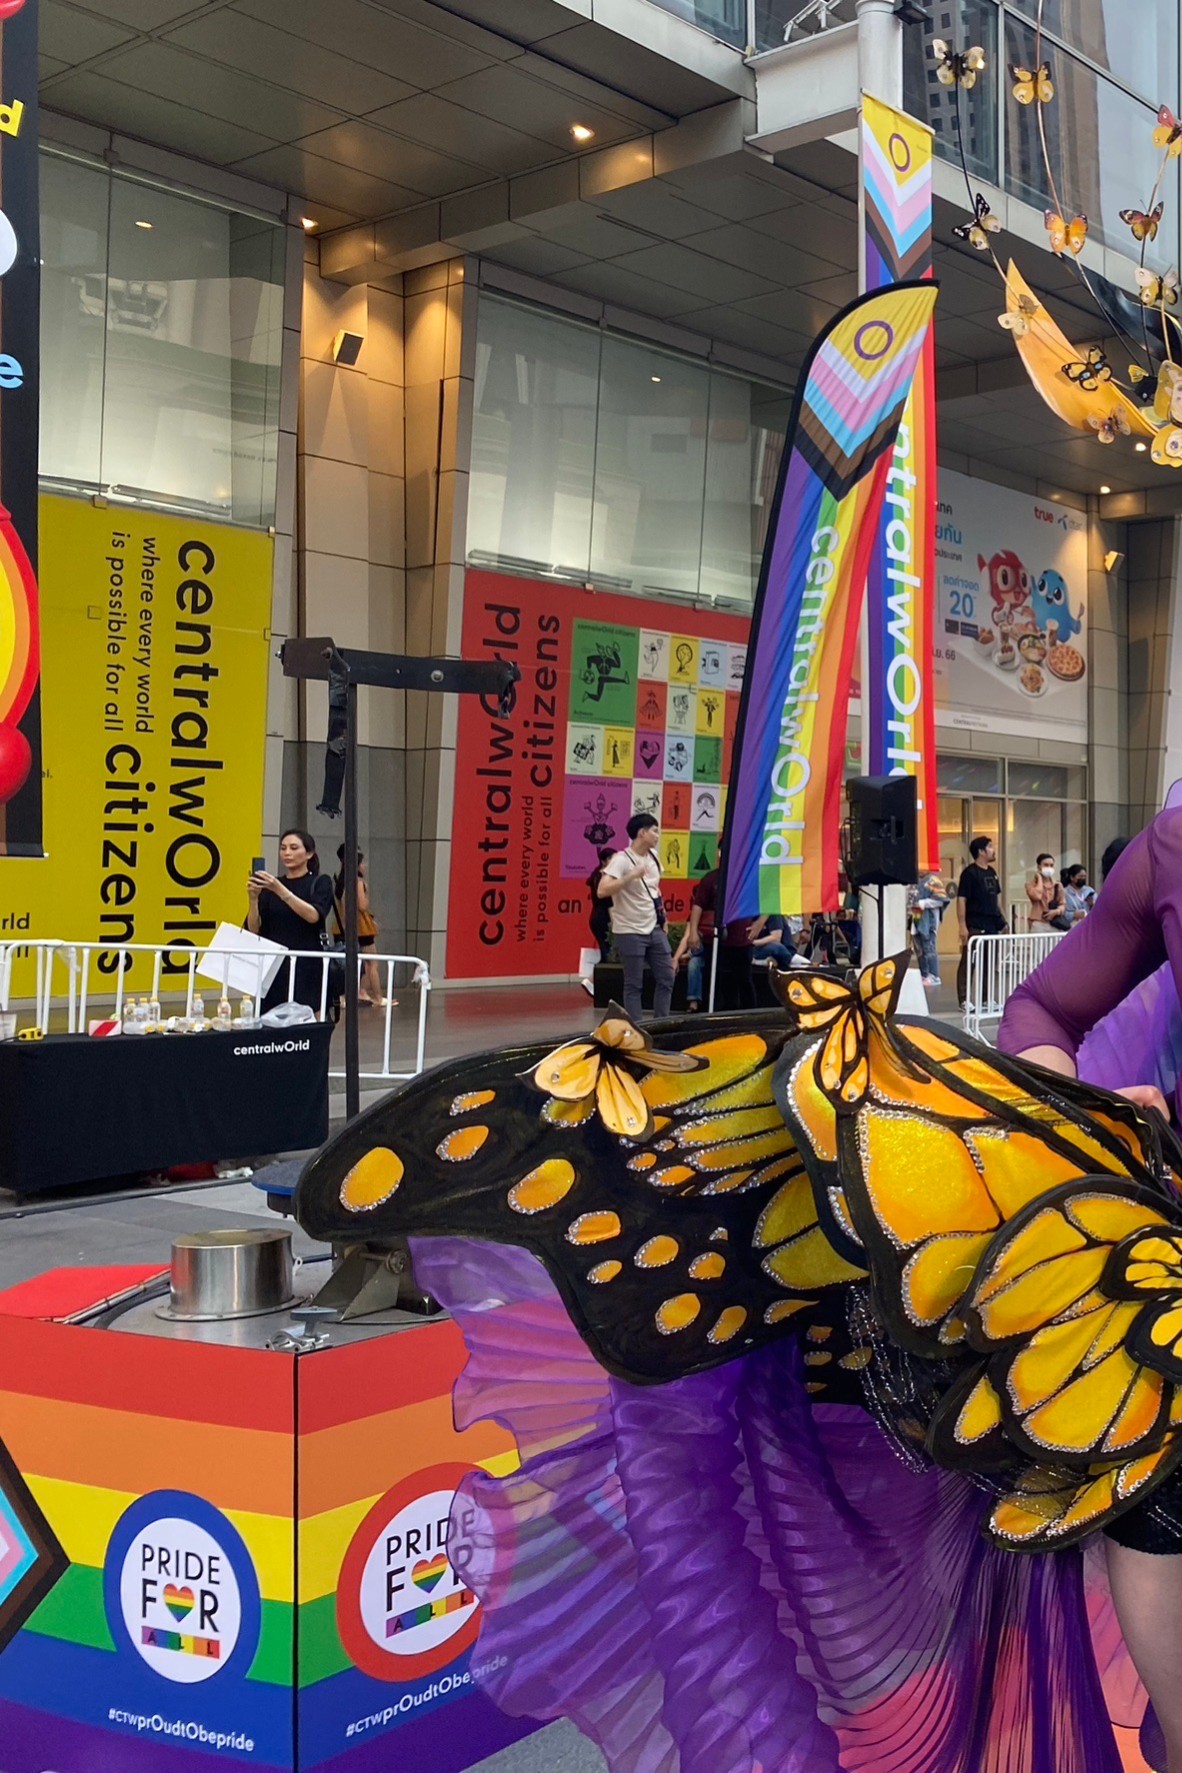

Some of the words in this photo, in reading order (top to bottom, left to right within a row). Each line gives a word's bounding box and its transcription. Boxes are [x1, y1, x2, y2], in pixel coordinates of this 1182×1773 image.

[1034, 506, 1054, 524] true
[111, 531, 131, 549] is
[140, 537, 161, 602] where
[105, 556, 128, 655] possible
[886, 402, 923, 810] ntralwOrl
[949, 590, 974, 618] 20
[132, 608, 153, 667] every
[105, 663, 126, 695] for
[521, 614, 560, 788] citizens
[759, 525, 839, 866] centralwOrld
[104, 702, 124, 731] all
[136, 674, 155, 733] world
[162, 540, 224, 974] centralwOrld
[476, 603, 521, 945] centralwOld
[521, 795, 534, 841] world
[540, 796, 553, 818] all
[97, 743, 156, 975] citizens
[538, 825, 551, 847] for
[519, 849, 534, 888] every
[535, 852, 550, 923] possible
[514, 894, 529, 942] where
[558, 899, 582, 913] an
[533, 928, 545, 942] is
[233, 1039, 310, 1056] centralwOrld
[386, 1508, 475, 1566] PRIDE
[141, 1543, 220, 1585] PRIDE
